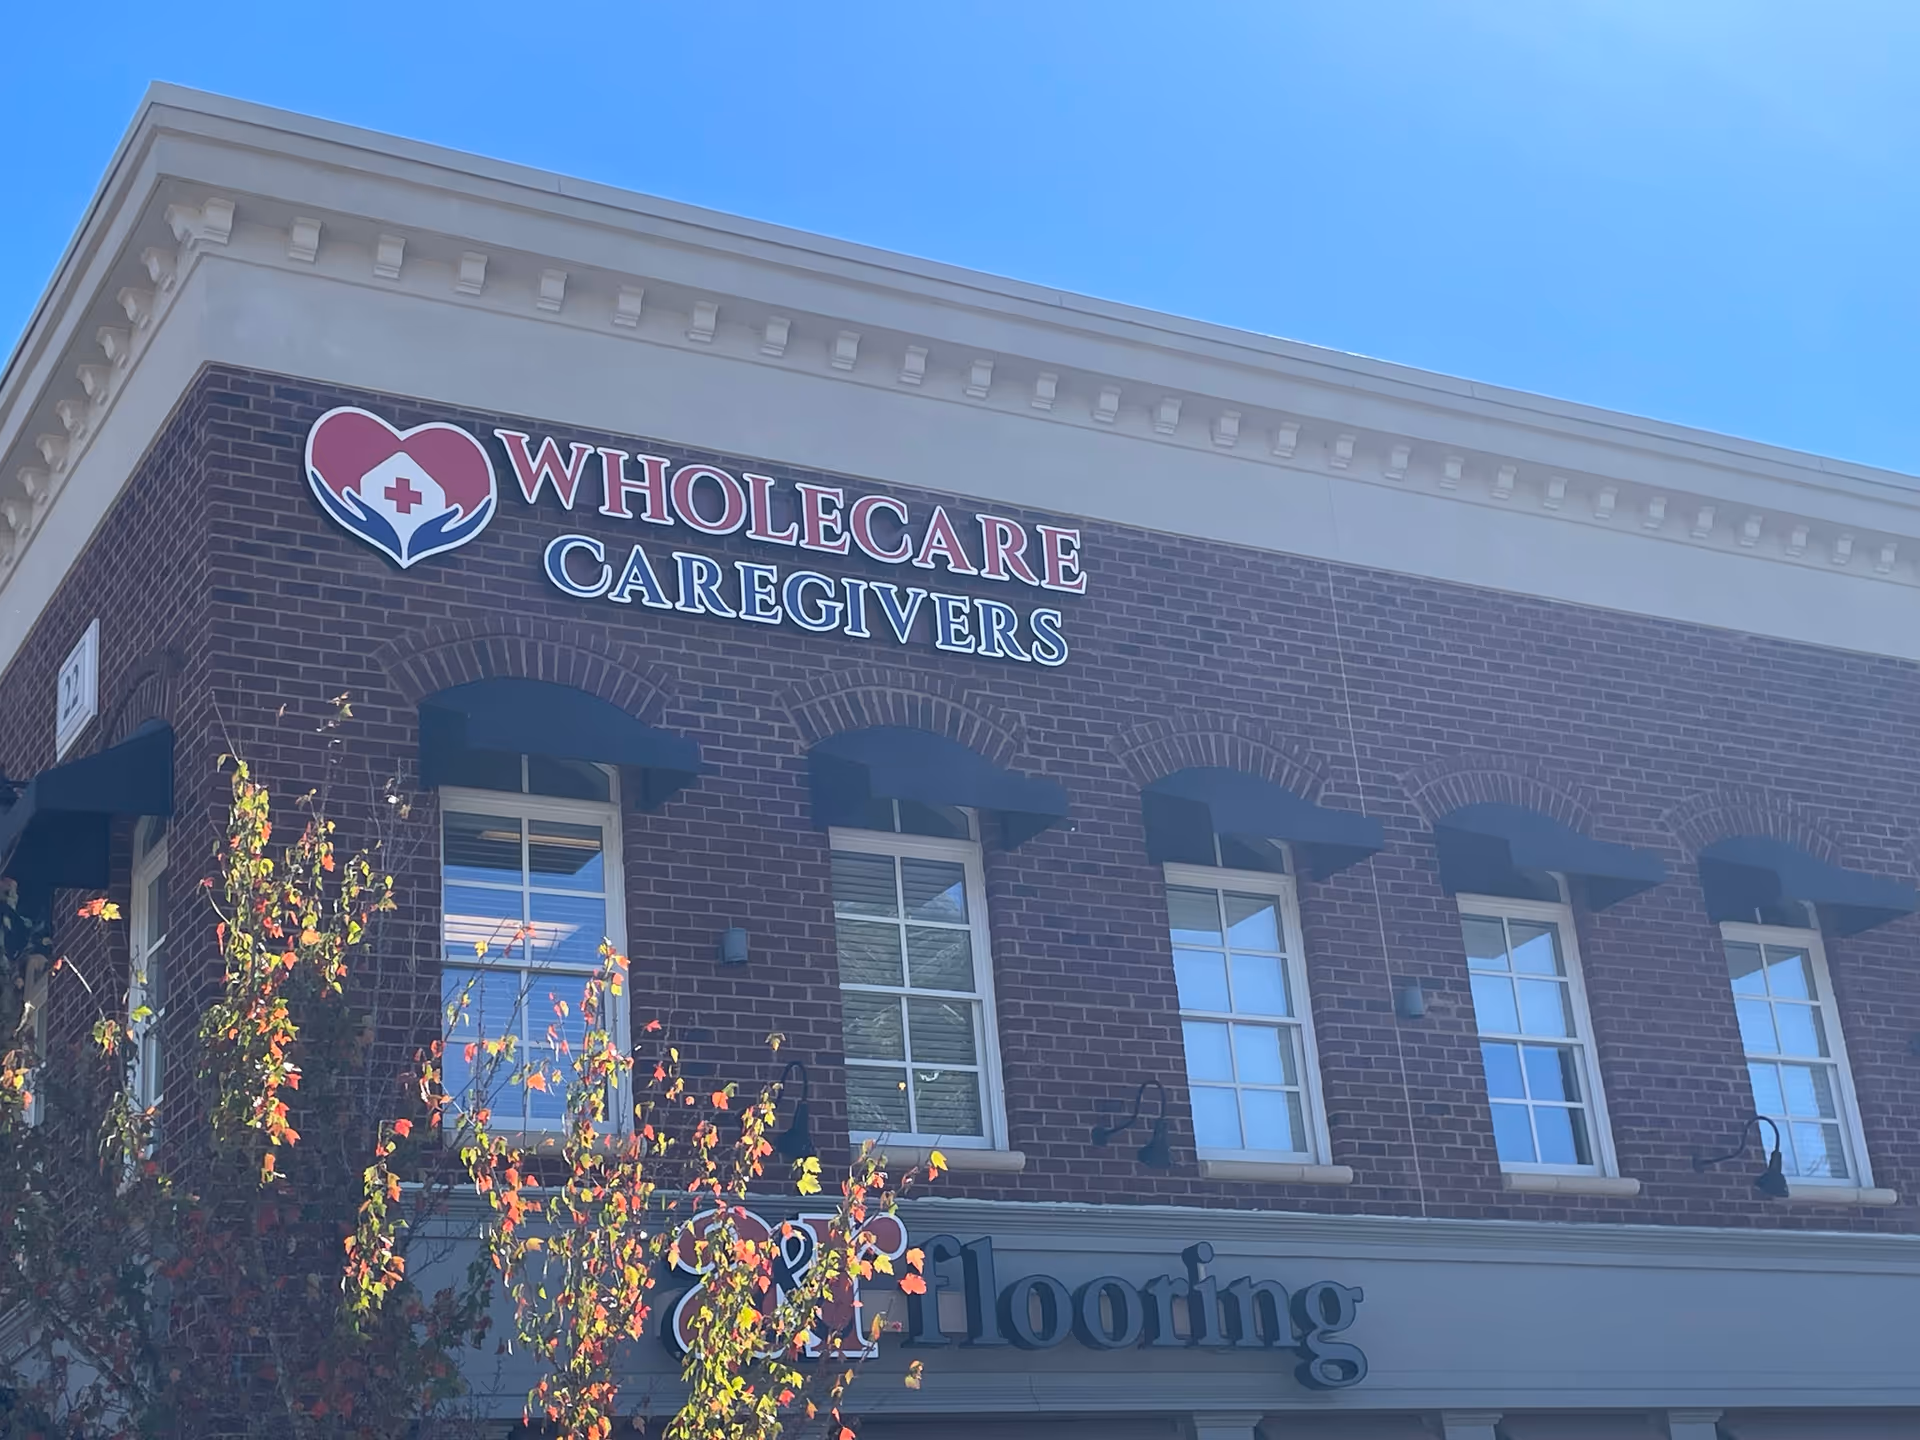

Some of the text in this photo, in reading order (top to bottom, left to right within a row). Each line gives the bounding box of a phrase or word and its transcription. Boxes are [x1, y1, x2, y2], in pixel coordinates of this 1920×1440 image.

[493, 428, 1087, 594] WHOLECARE
[544, 534, 1069, 666] CAREGIVERS
[63, 664, 79, 720] 22
[907, 1234, 1368, 1388] flooring
